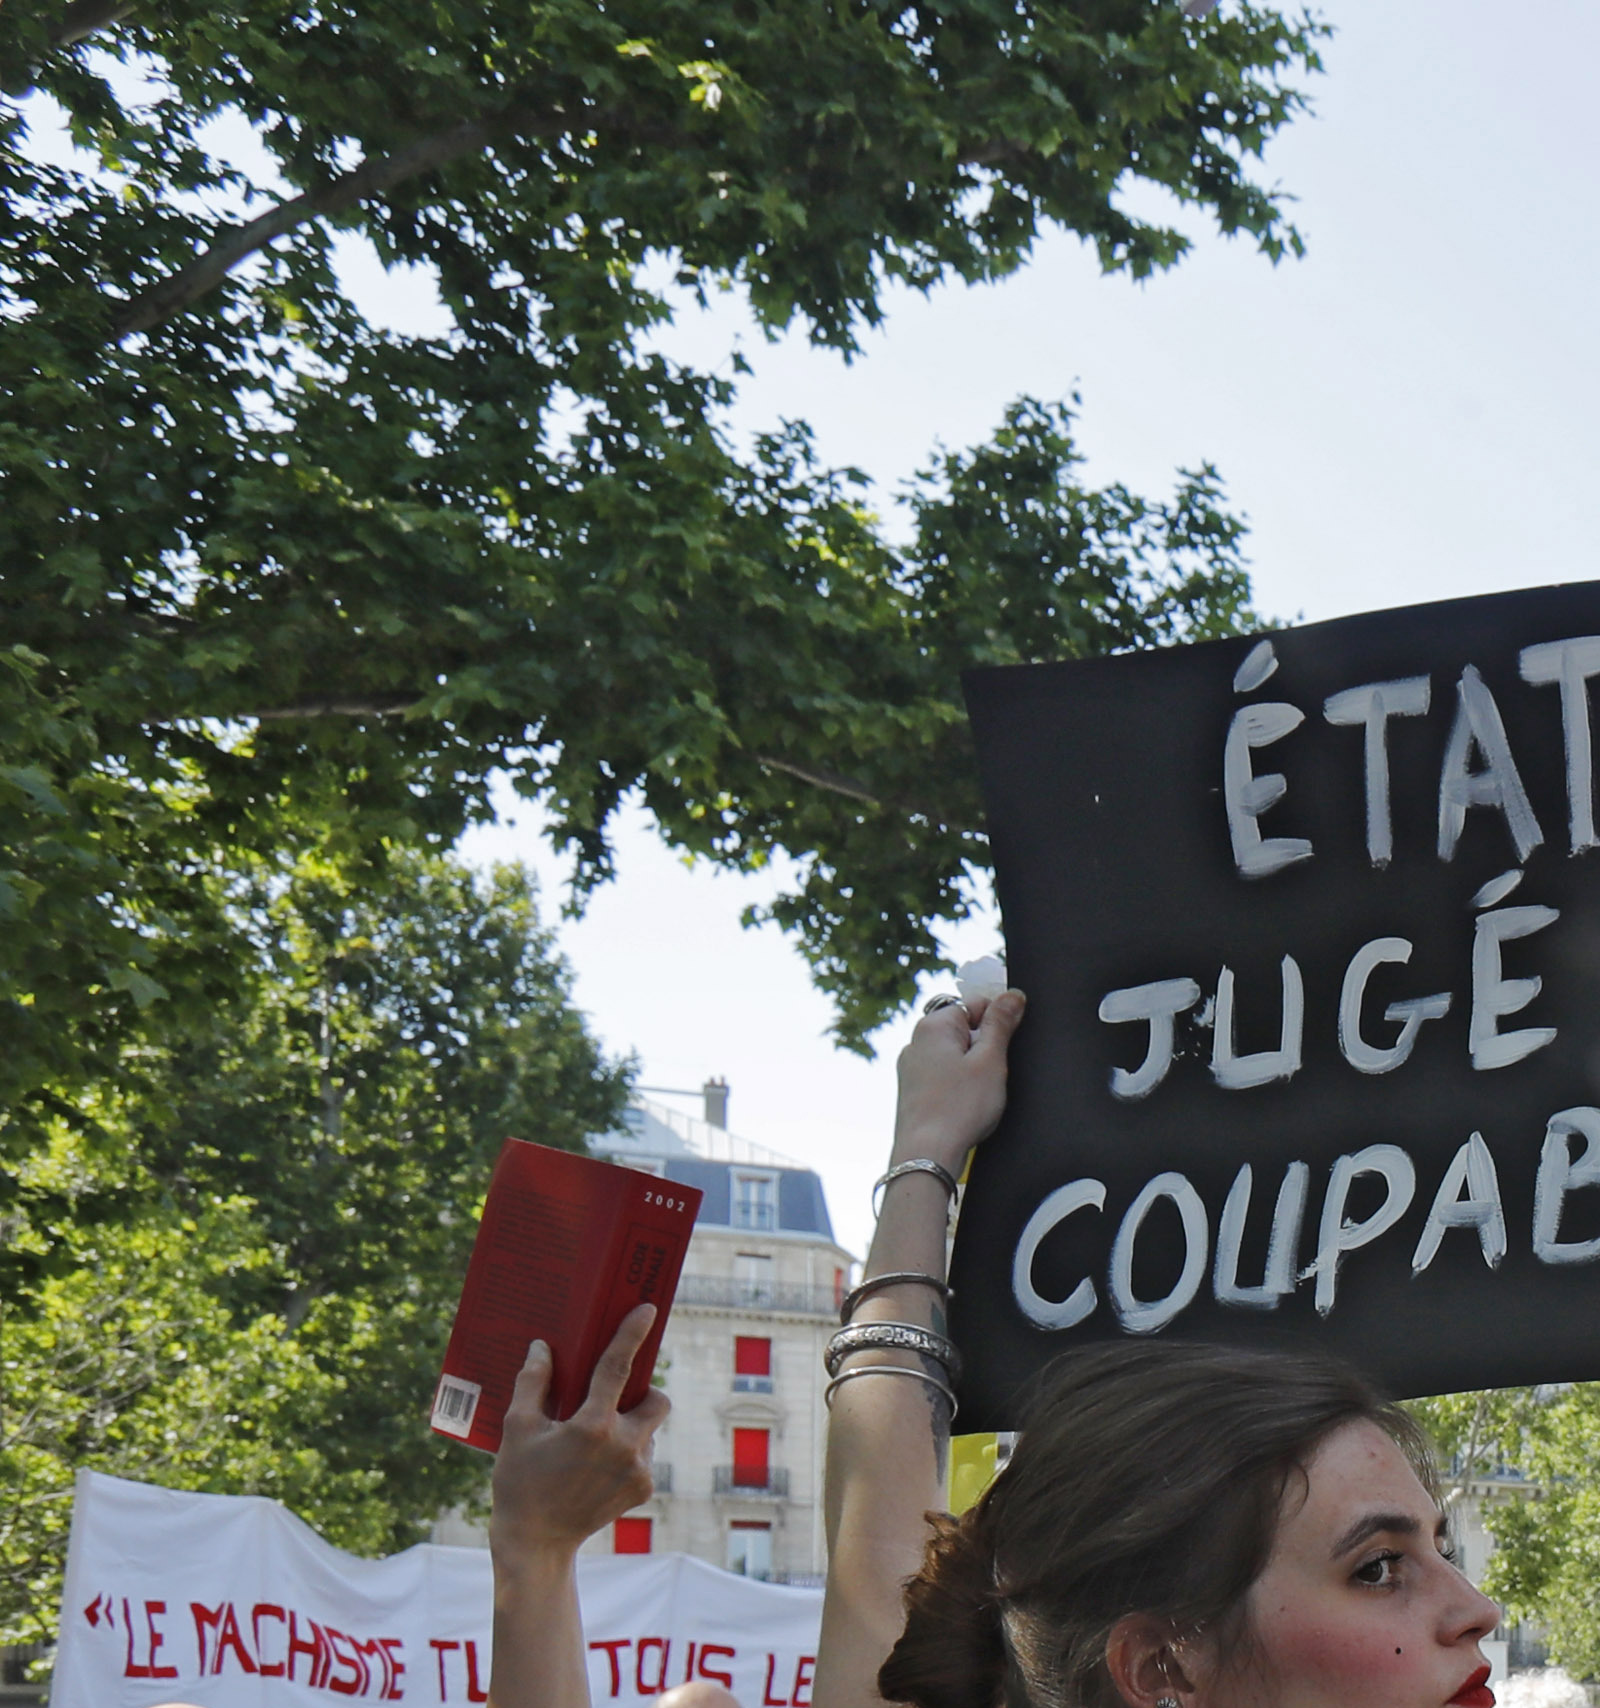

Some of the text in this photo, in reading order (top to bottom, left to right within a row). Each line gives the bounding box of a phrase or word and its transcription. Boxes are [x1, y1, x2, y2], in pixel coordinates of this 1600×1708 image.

[1098, 869, 1560, 1101] JUGÉ
[644, 1191, 685, 1212] 2002
[627, 1241, 650, 1285] CODE
[190, 1602, 406, 1700] MACHISME
[429, 1639, 489, 1703] TU
[589, 1637, 735, 1698] TOUS
